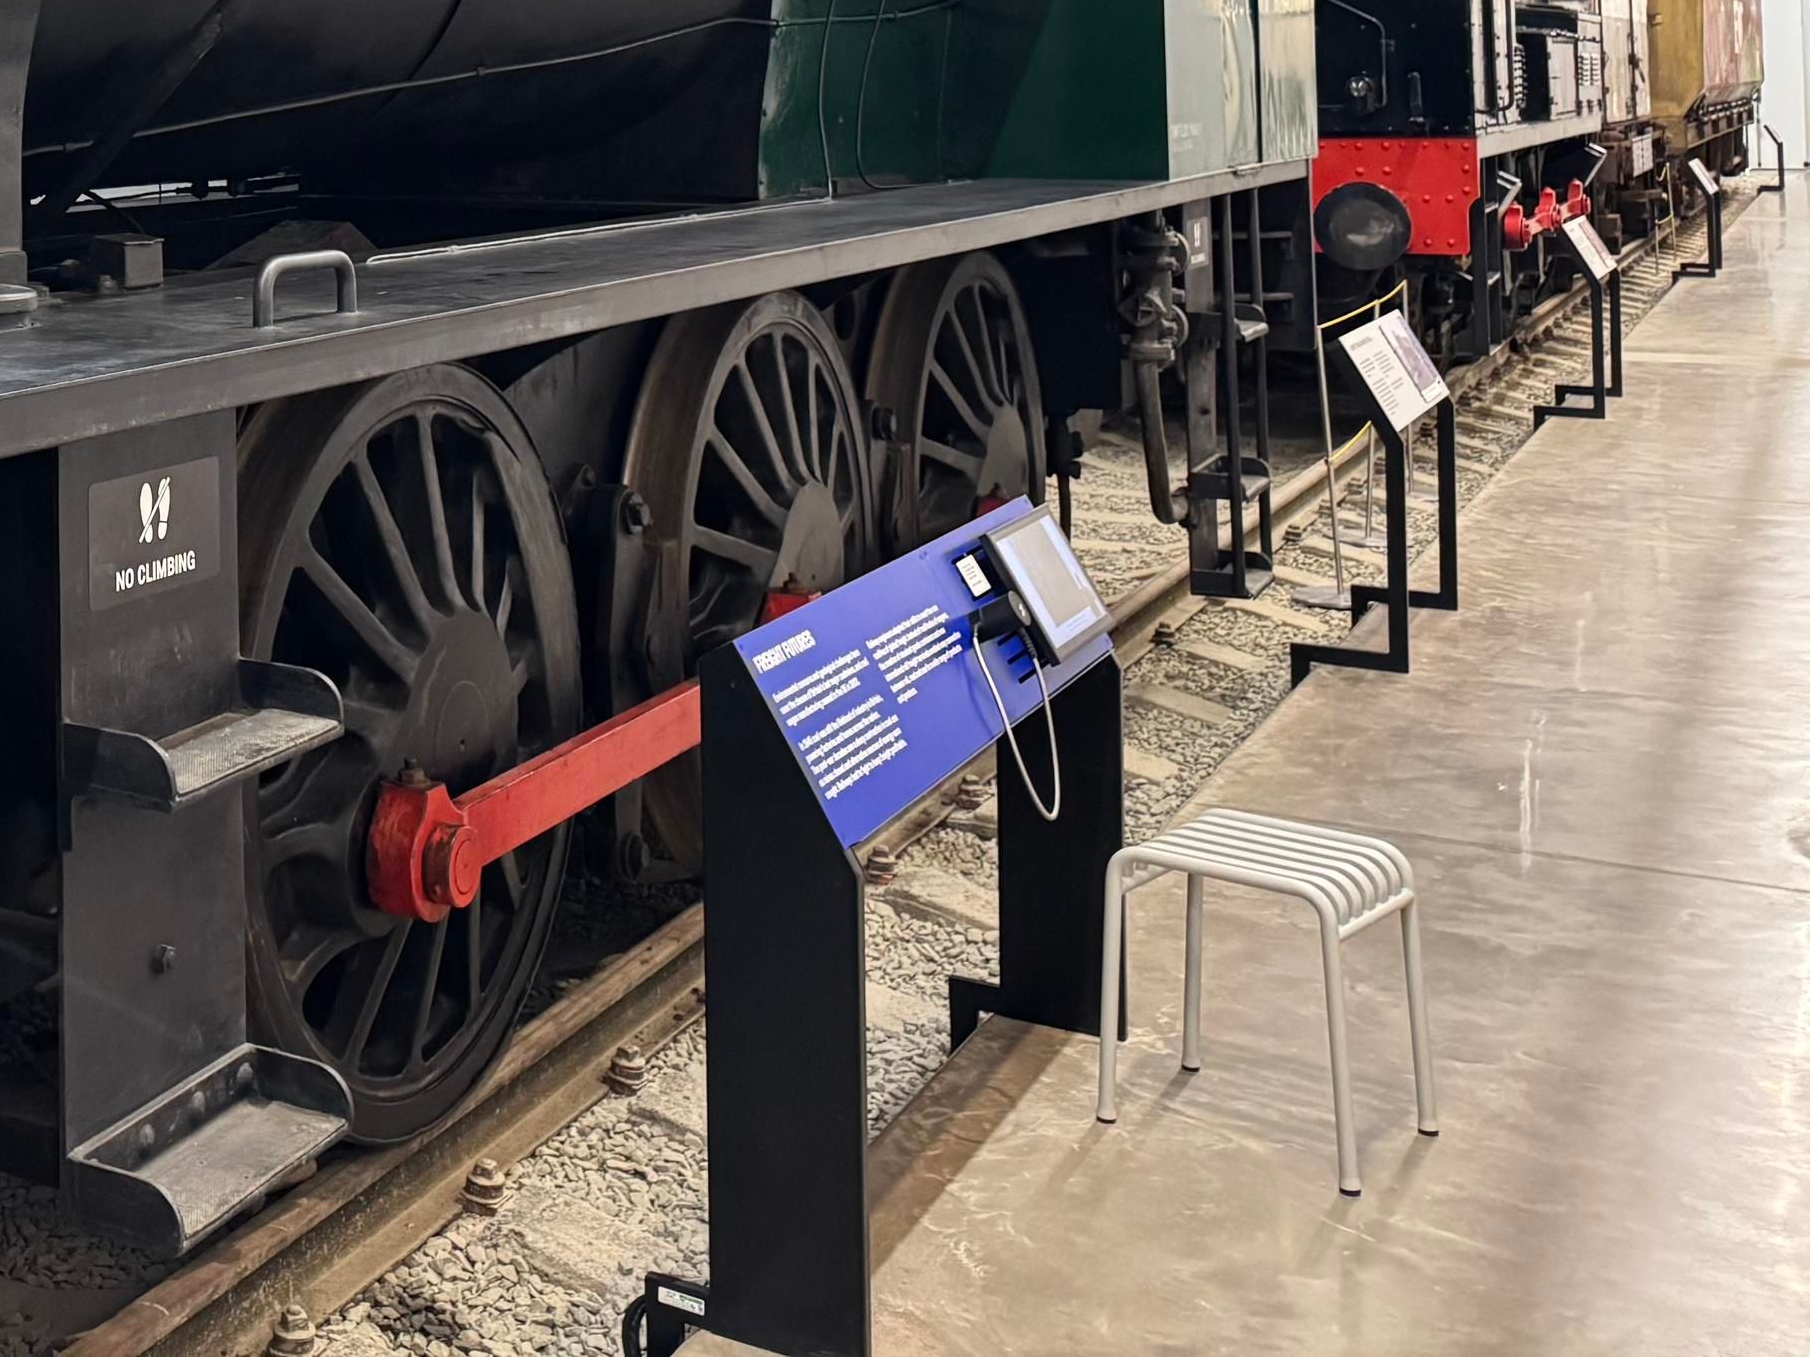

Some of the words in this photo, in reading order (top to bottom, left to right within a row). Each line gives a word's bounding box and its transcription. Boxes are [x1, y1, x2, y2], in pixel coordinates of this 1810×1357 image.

[115, 567, 135, 592] NO
[137, 550, 196, 585] CLIMBING
[752, 644, 787, 674] FREIGHT
[783, 629, 817, 658] FUTURES
